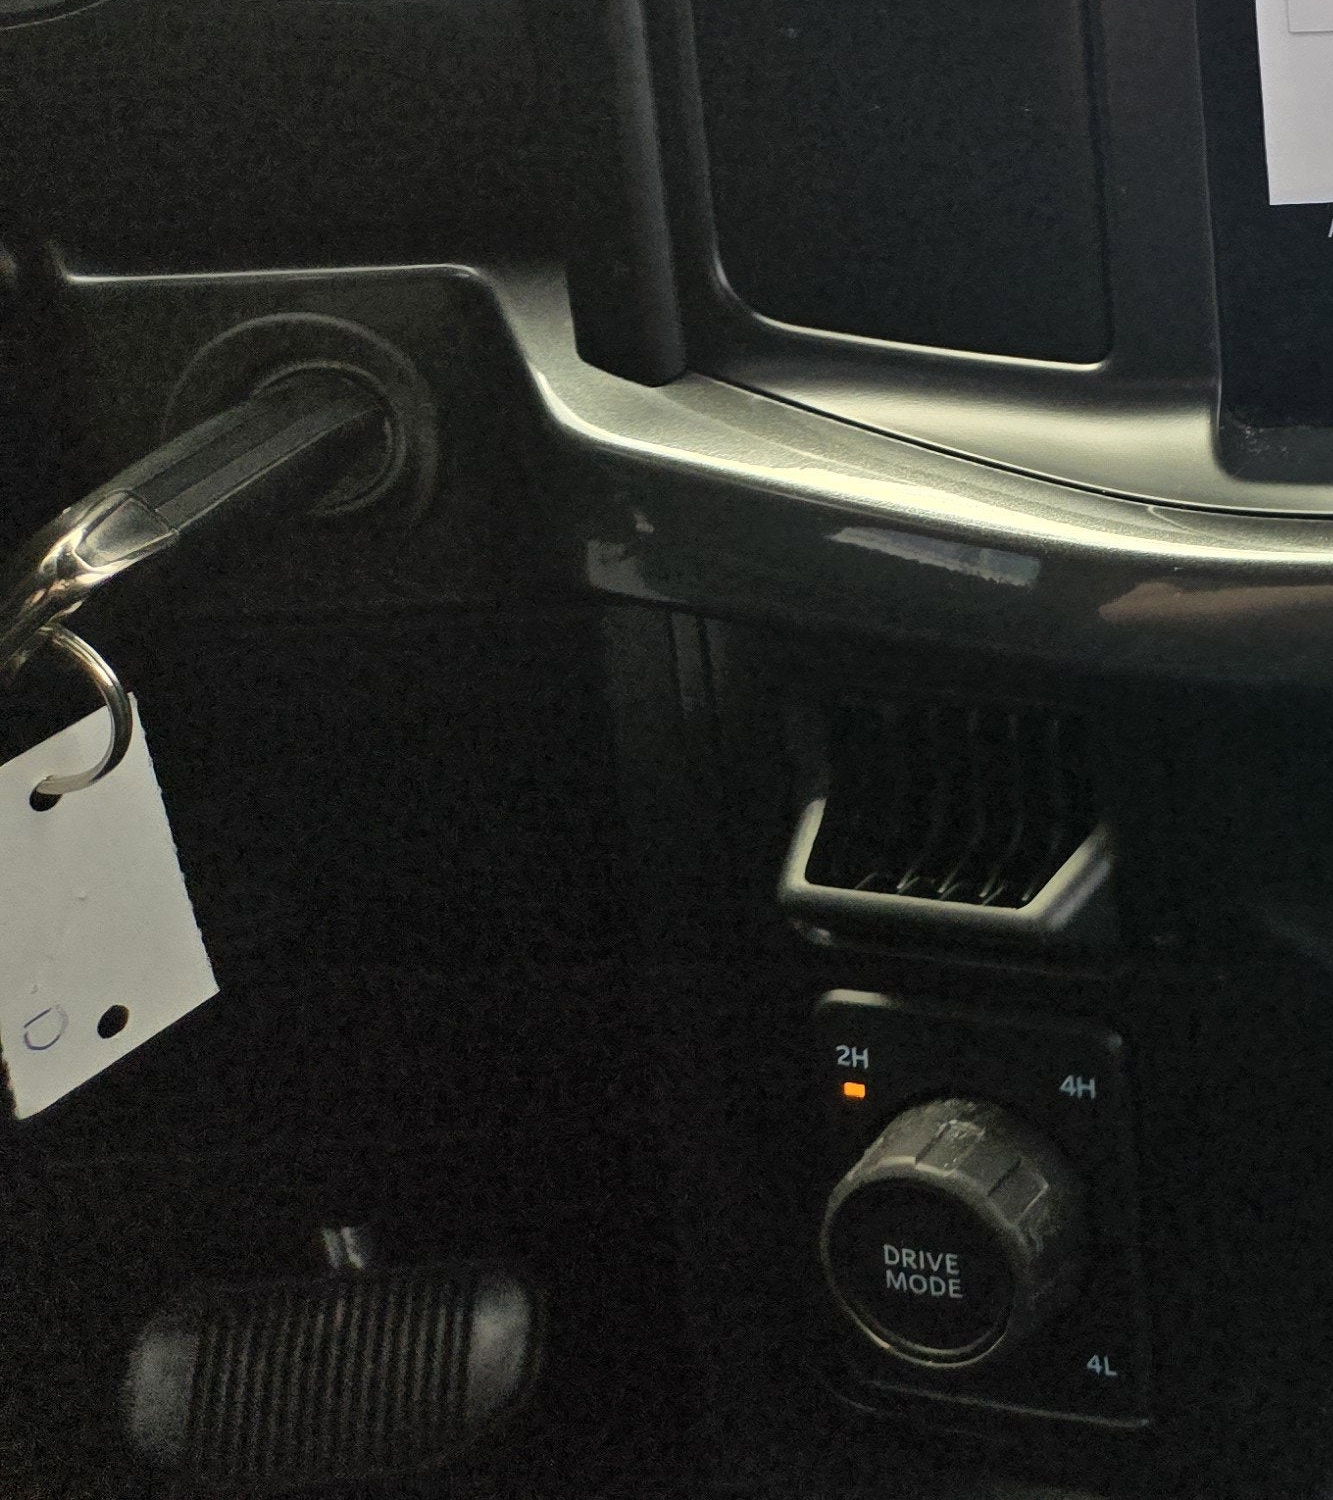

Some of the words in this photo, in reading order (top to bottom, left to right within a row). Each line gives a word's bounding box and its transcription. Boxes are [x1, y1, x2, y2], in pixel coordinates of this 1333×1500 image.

[835, 1044, 869, 1069] 2H
[1059, 1074, 1096, 1099] 4H
[883, 1244, 959, 1276] DRIVE
[885, 1269, 963, 1299] MODE
[1086, 1354, 1118, 1377] 4L
